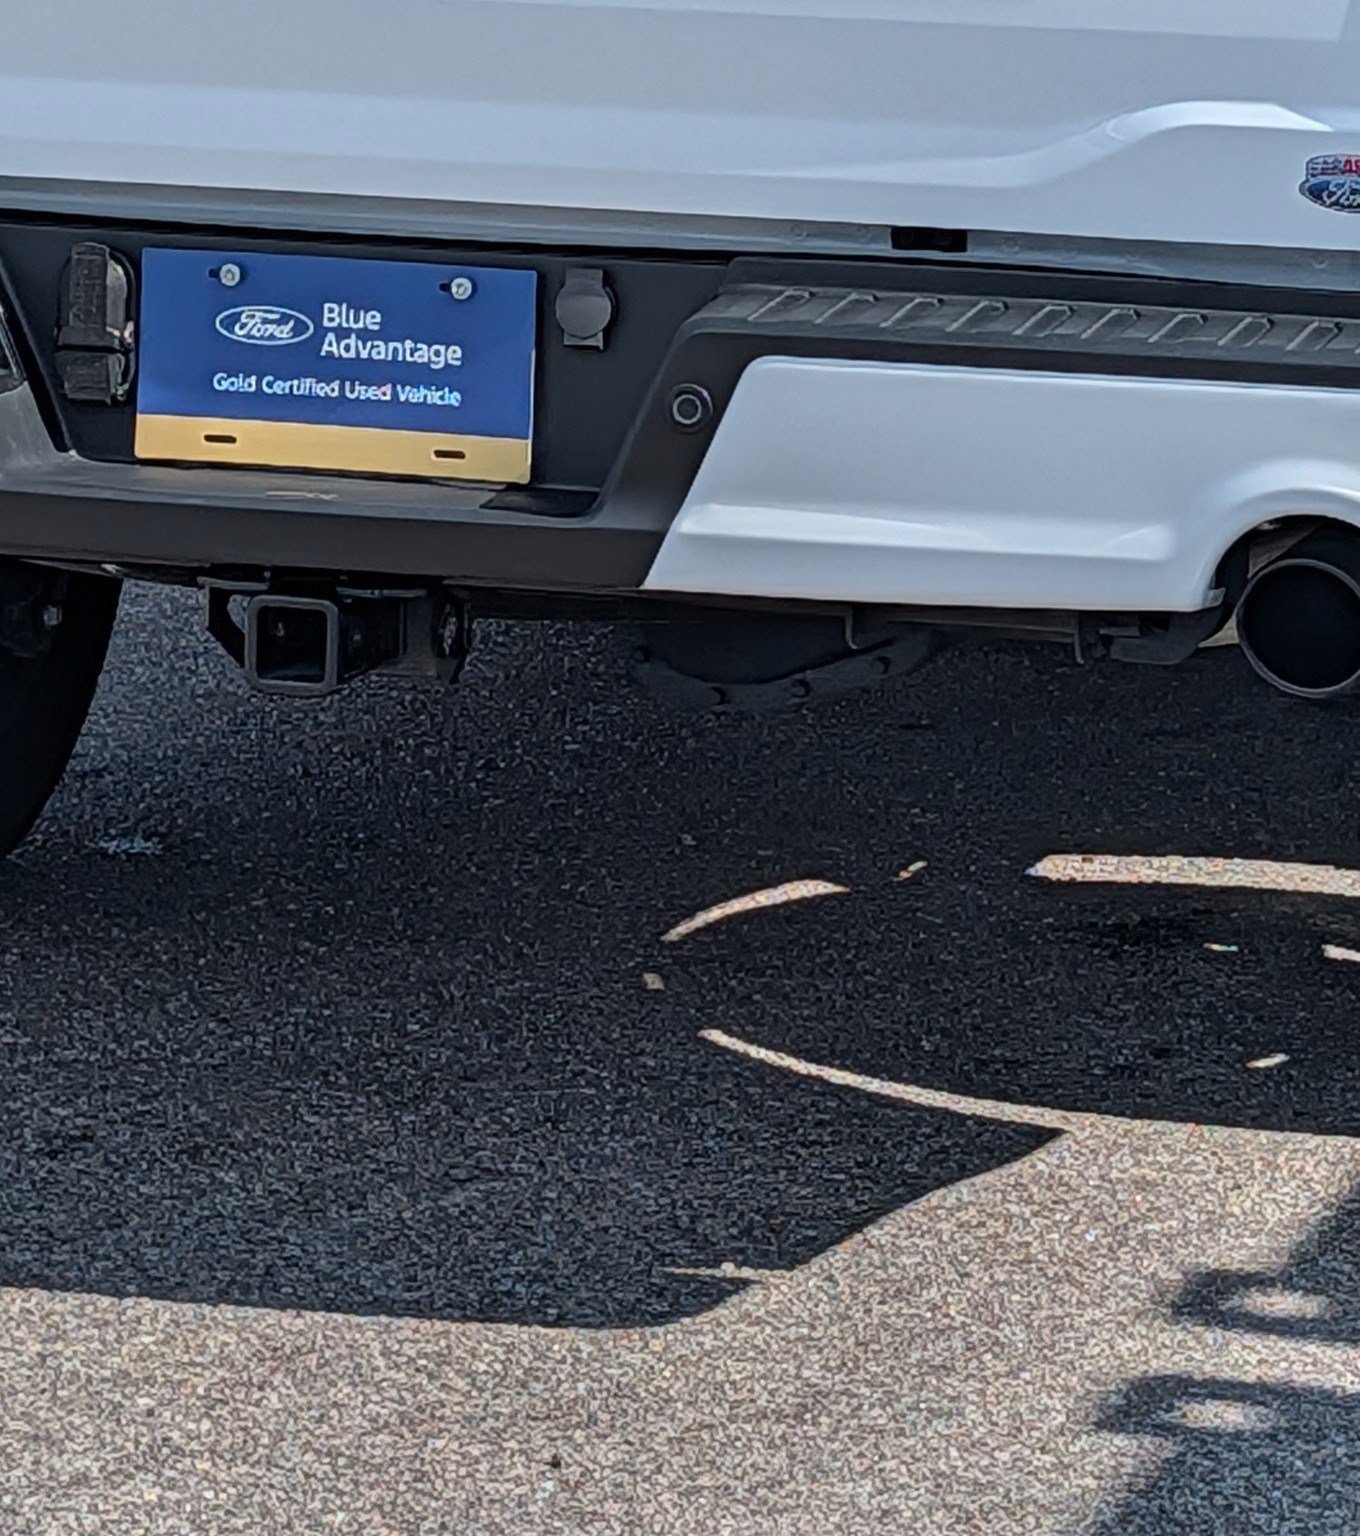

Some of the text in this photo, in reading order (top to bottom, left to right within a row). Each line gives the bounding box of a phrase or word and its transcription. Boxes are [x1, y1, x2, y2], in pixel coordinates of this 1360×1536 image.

[234, 310, 295, 339] Ford
[322, 302, 382, 330] Blue
[320, 332, 463, 370] Advantage
[213, 372, 462, 407] Gold Certified Used Vehicle
